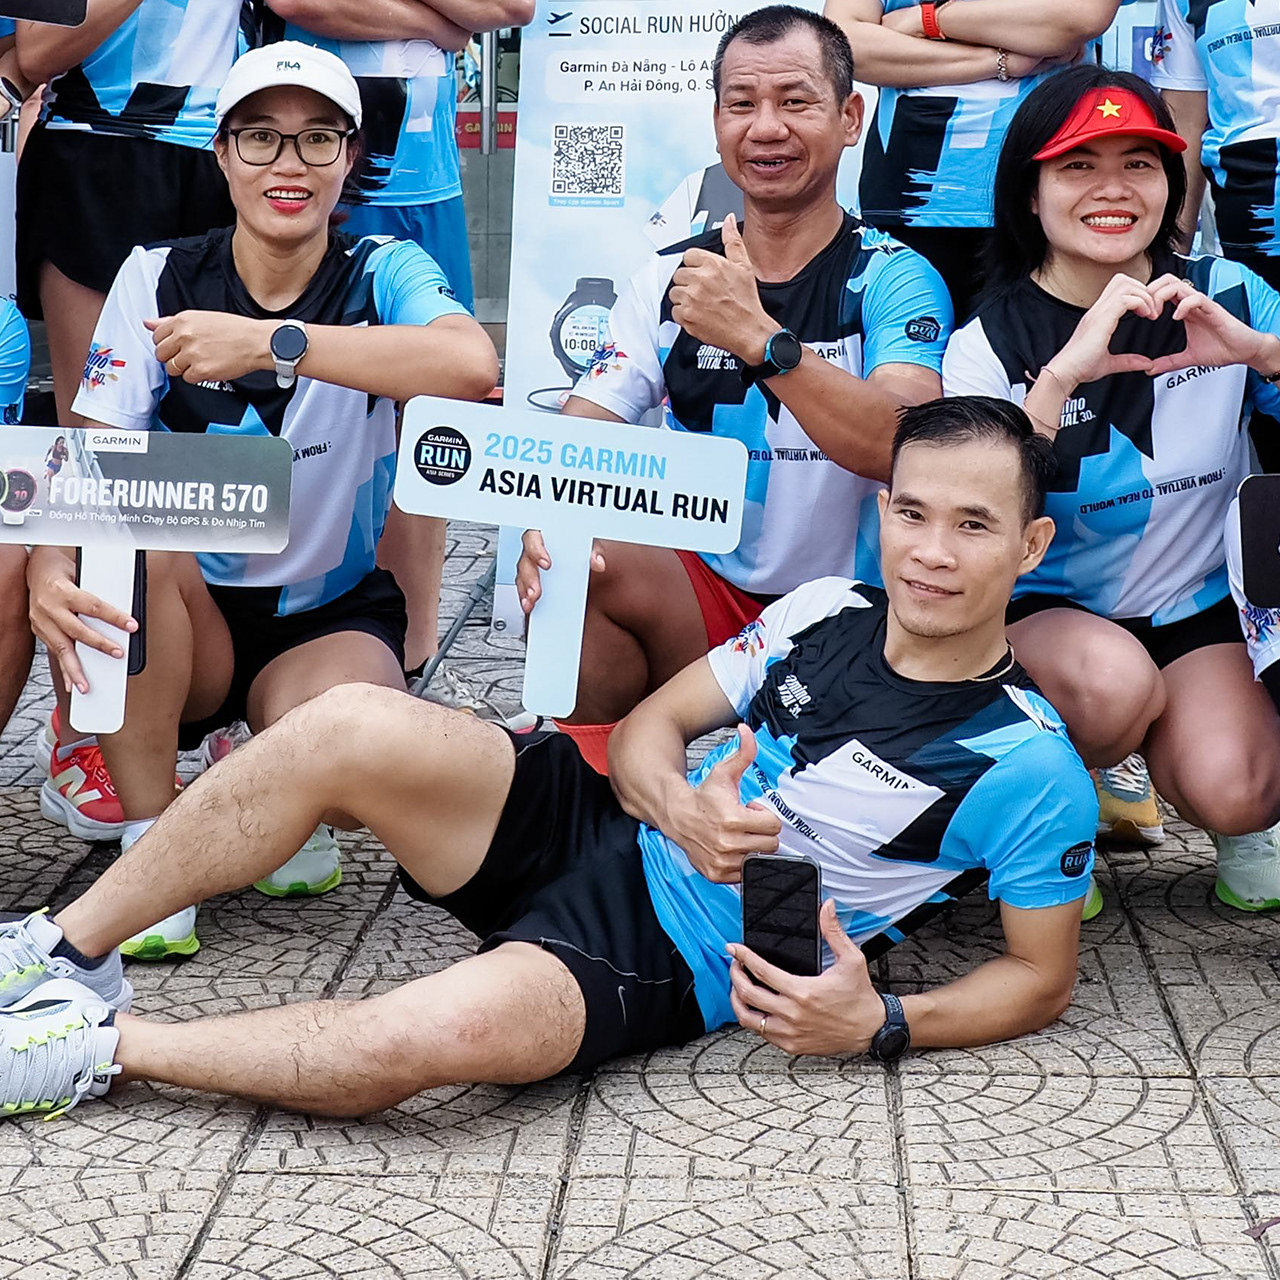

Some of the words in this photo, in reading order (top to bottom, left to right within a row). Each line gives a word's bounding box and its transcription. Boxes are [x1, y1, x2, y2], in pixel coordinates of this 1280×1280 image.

[579, 14, 641, 36] SOCIAL
[646, 14, 684, 34] RUN
[277, 61, 301, 70] FILA
[560, 61, 607, 73] Garmin
[611, 60, 629, 72] Đà
[680, 59, 696, 72] Lô
[584, 80, 594, 91] P.
[598, 79, 616, 91] An
[620, 78, 642, 91] Hải
[645, 78, 683, 94] Đông,
[687, 79, 701, 91] Q.
[564, 338, 596, 351] 10:08
[698, 356, 721, 370] VITAL
[92, 435, 142, 447] GARMIN
[427, 433, 463, 445] GARMIN
[302, 442, 328, 459] FROM
[420, 444, 466, 470] RUN
[484, 432, 553, 465] 2025
[560, 443, 667, 480] GARMIN
[761, 450, 774, 461] TO
[774, 448, 808, 461] VIRTUAL
[1155, 475, 1196, 495] VIRTUAL
[1198, 469, 1223, 486] FROM
[49, 476, 215, 511] FORERUNNER
[221, 483, 268, 514] 570
[479, 467, 542, 500] ASIA
[551, 477, 664, 516] VIRTUAL
[671, 493, 729, 524] RUN
[1117, 492, 1140, 505] REAL
[1142, 488, 1155, 500] TO
[1079, 499, 1116, 514] WORLD
[119, 513, 140, 523] Minh
[142, 514, 164, 526] Chạy
[180, 516, 200, 526] GPS
[201, 518, 209, 526] &
[211, 518, 224, 527] Đo
[249, 519, 265, 529] Tim
